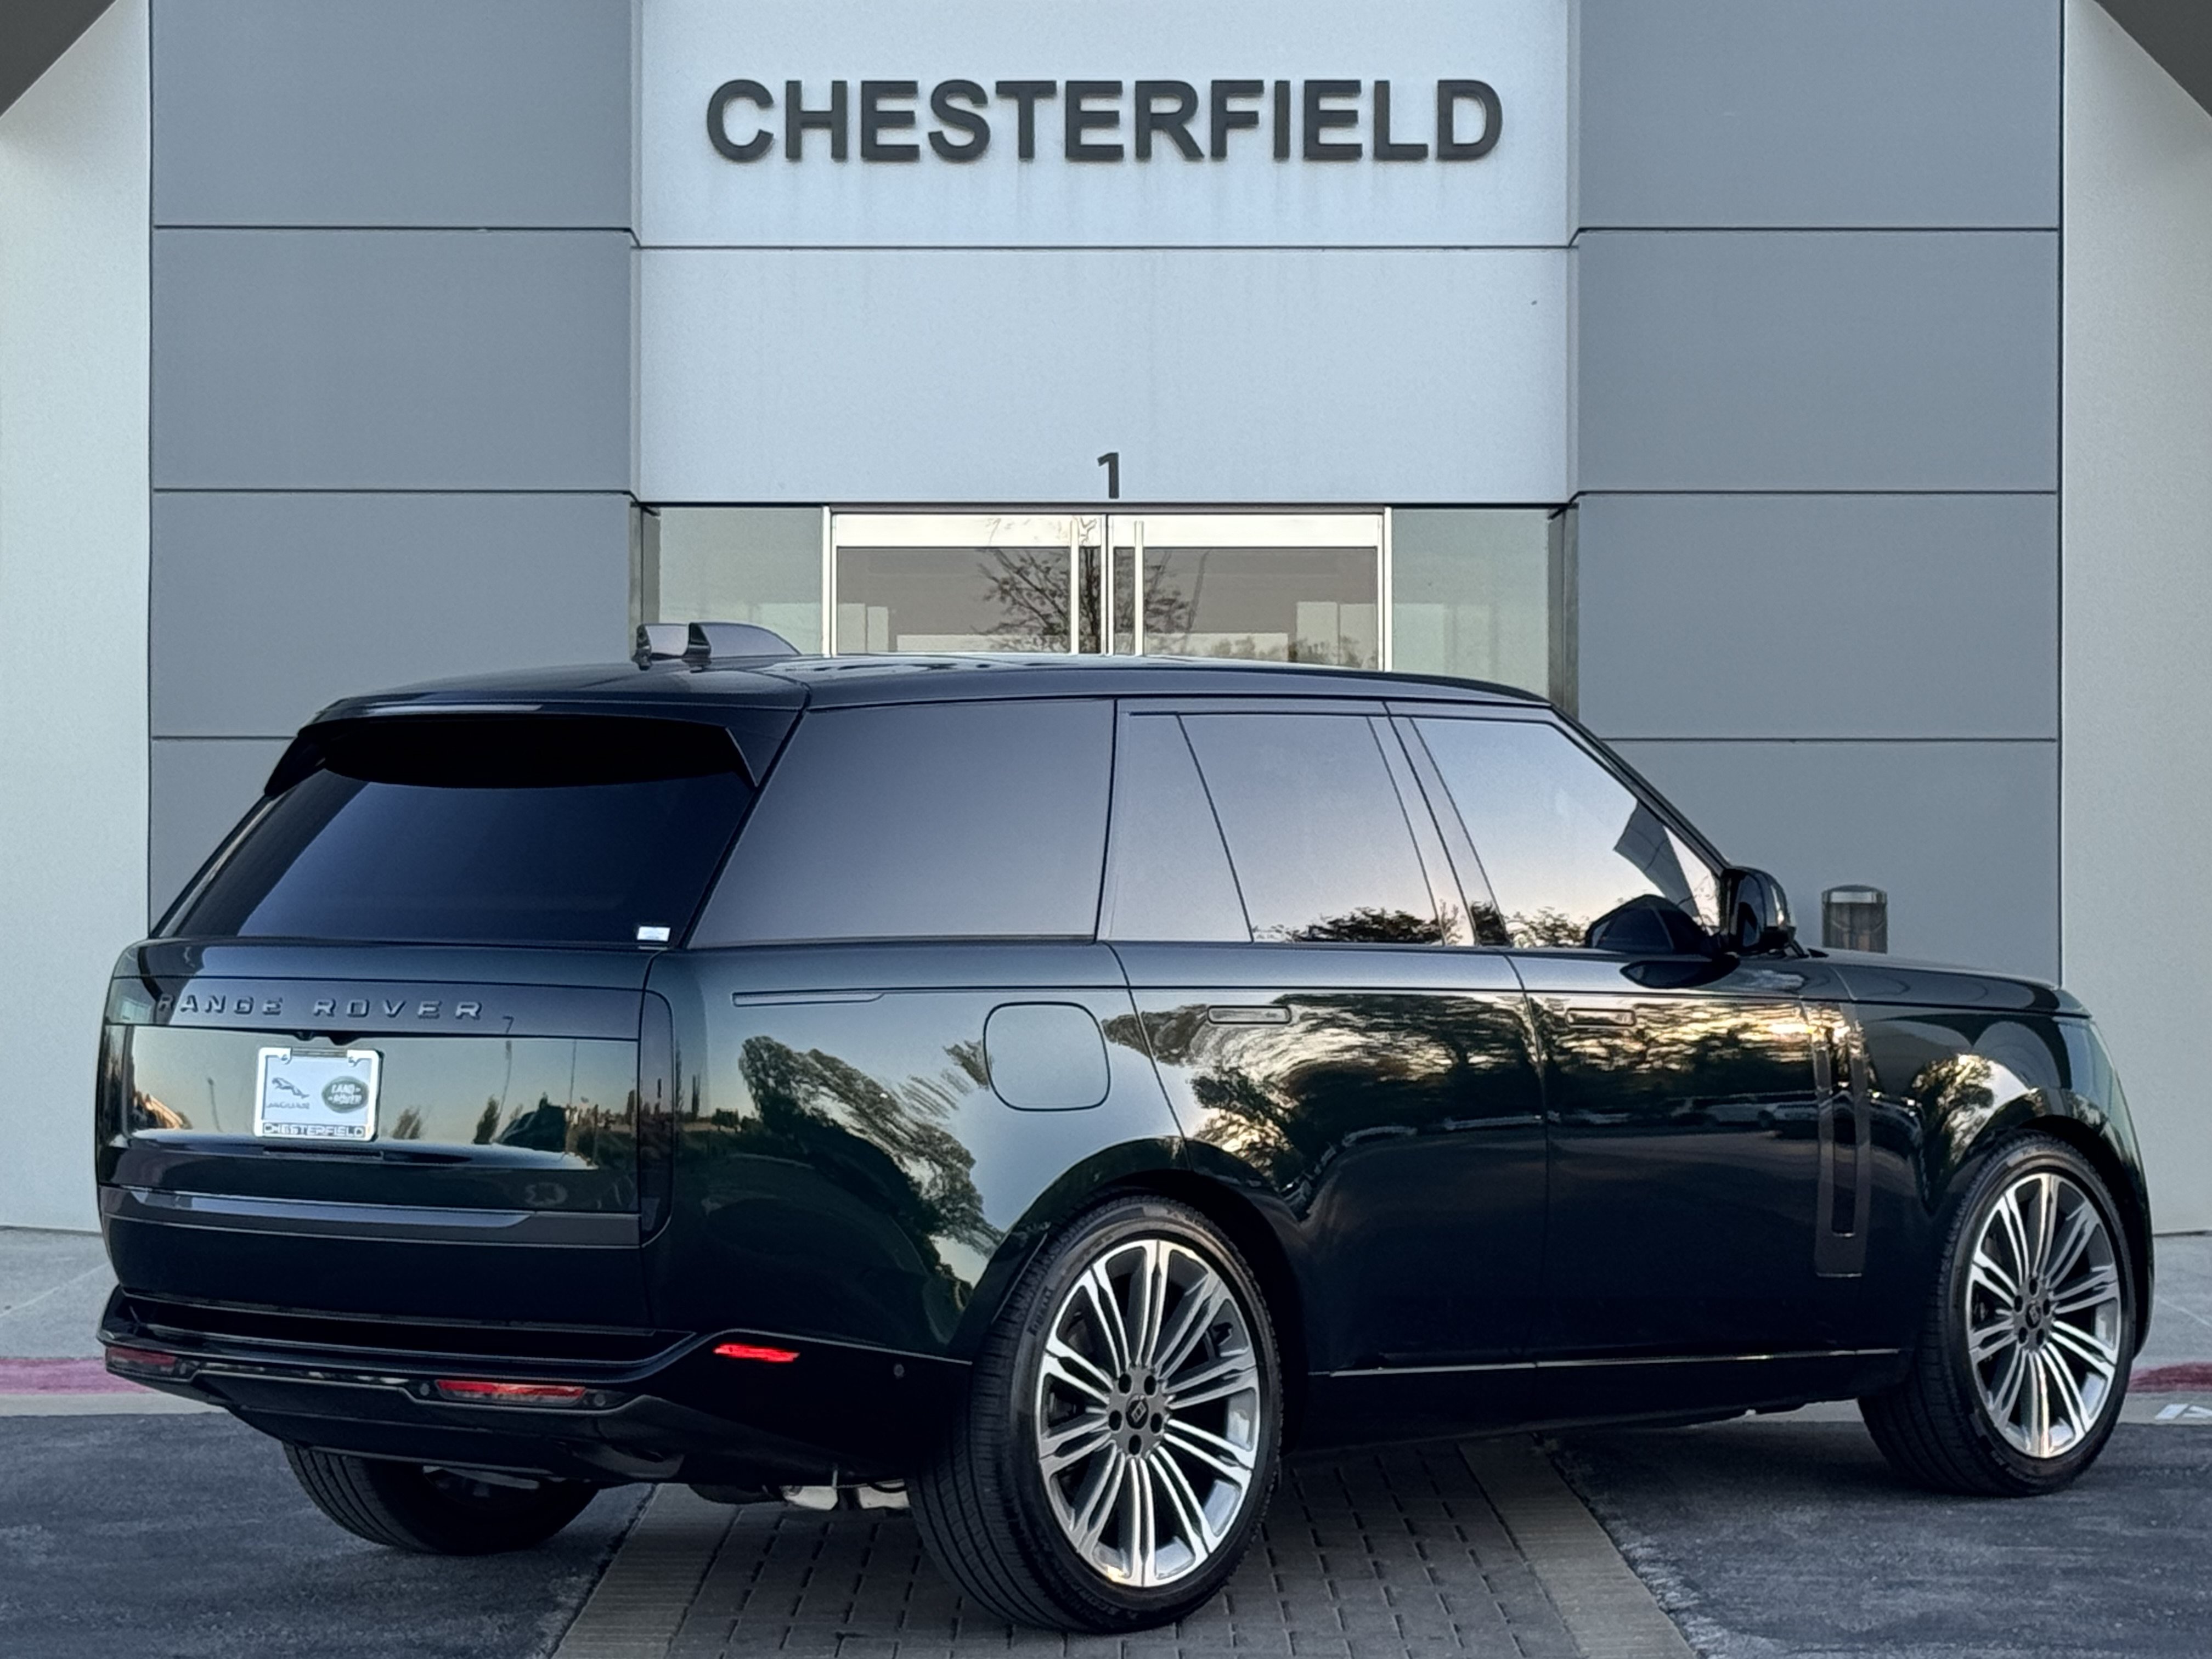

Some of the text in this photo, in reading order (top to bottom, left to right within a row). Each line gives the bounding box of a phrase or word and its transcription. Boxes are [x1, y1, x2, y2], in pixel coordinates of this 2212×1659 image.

[706, 78, 1503, 163] CHESTERFIELD
[1096, 452, 1121, 499] 1
[158, 994, 482, 1019] RANGE ROVER
[263, 1122, 364, 1138] CHESTERFIELD
